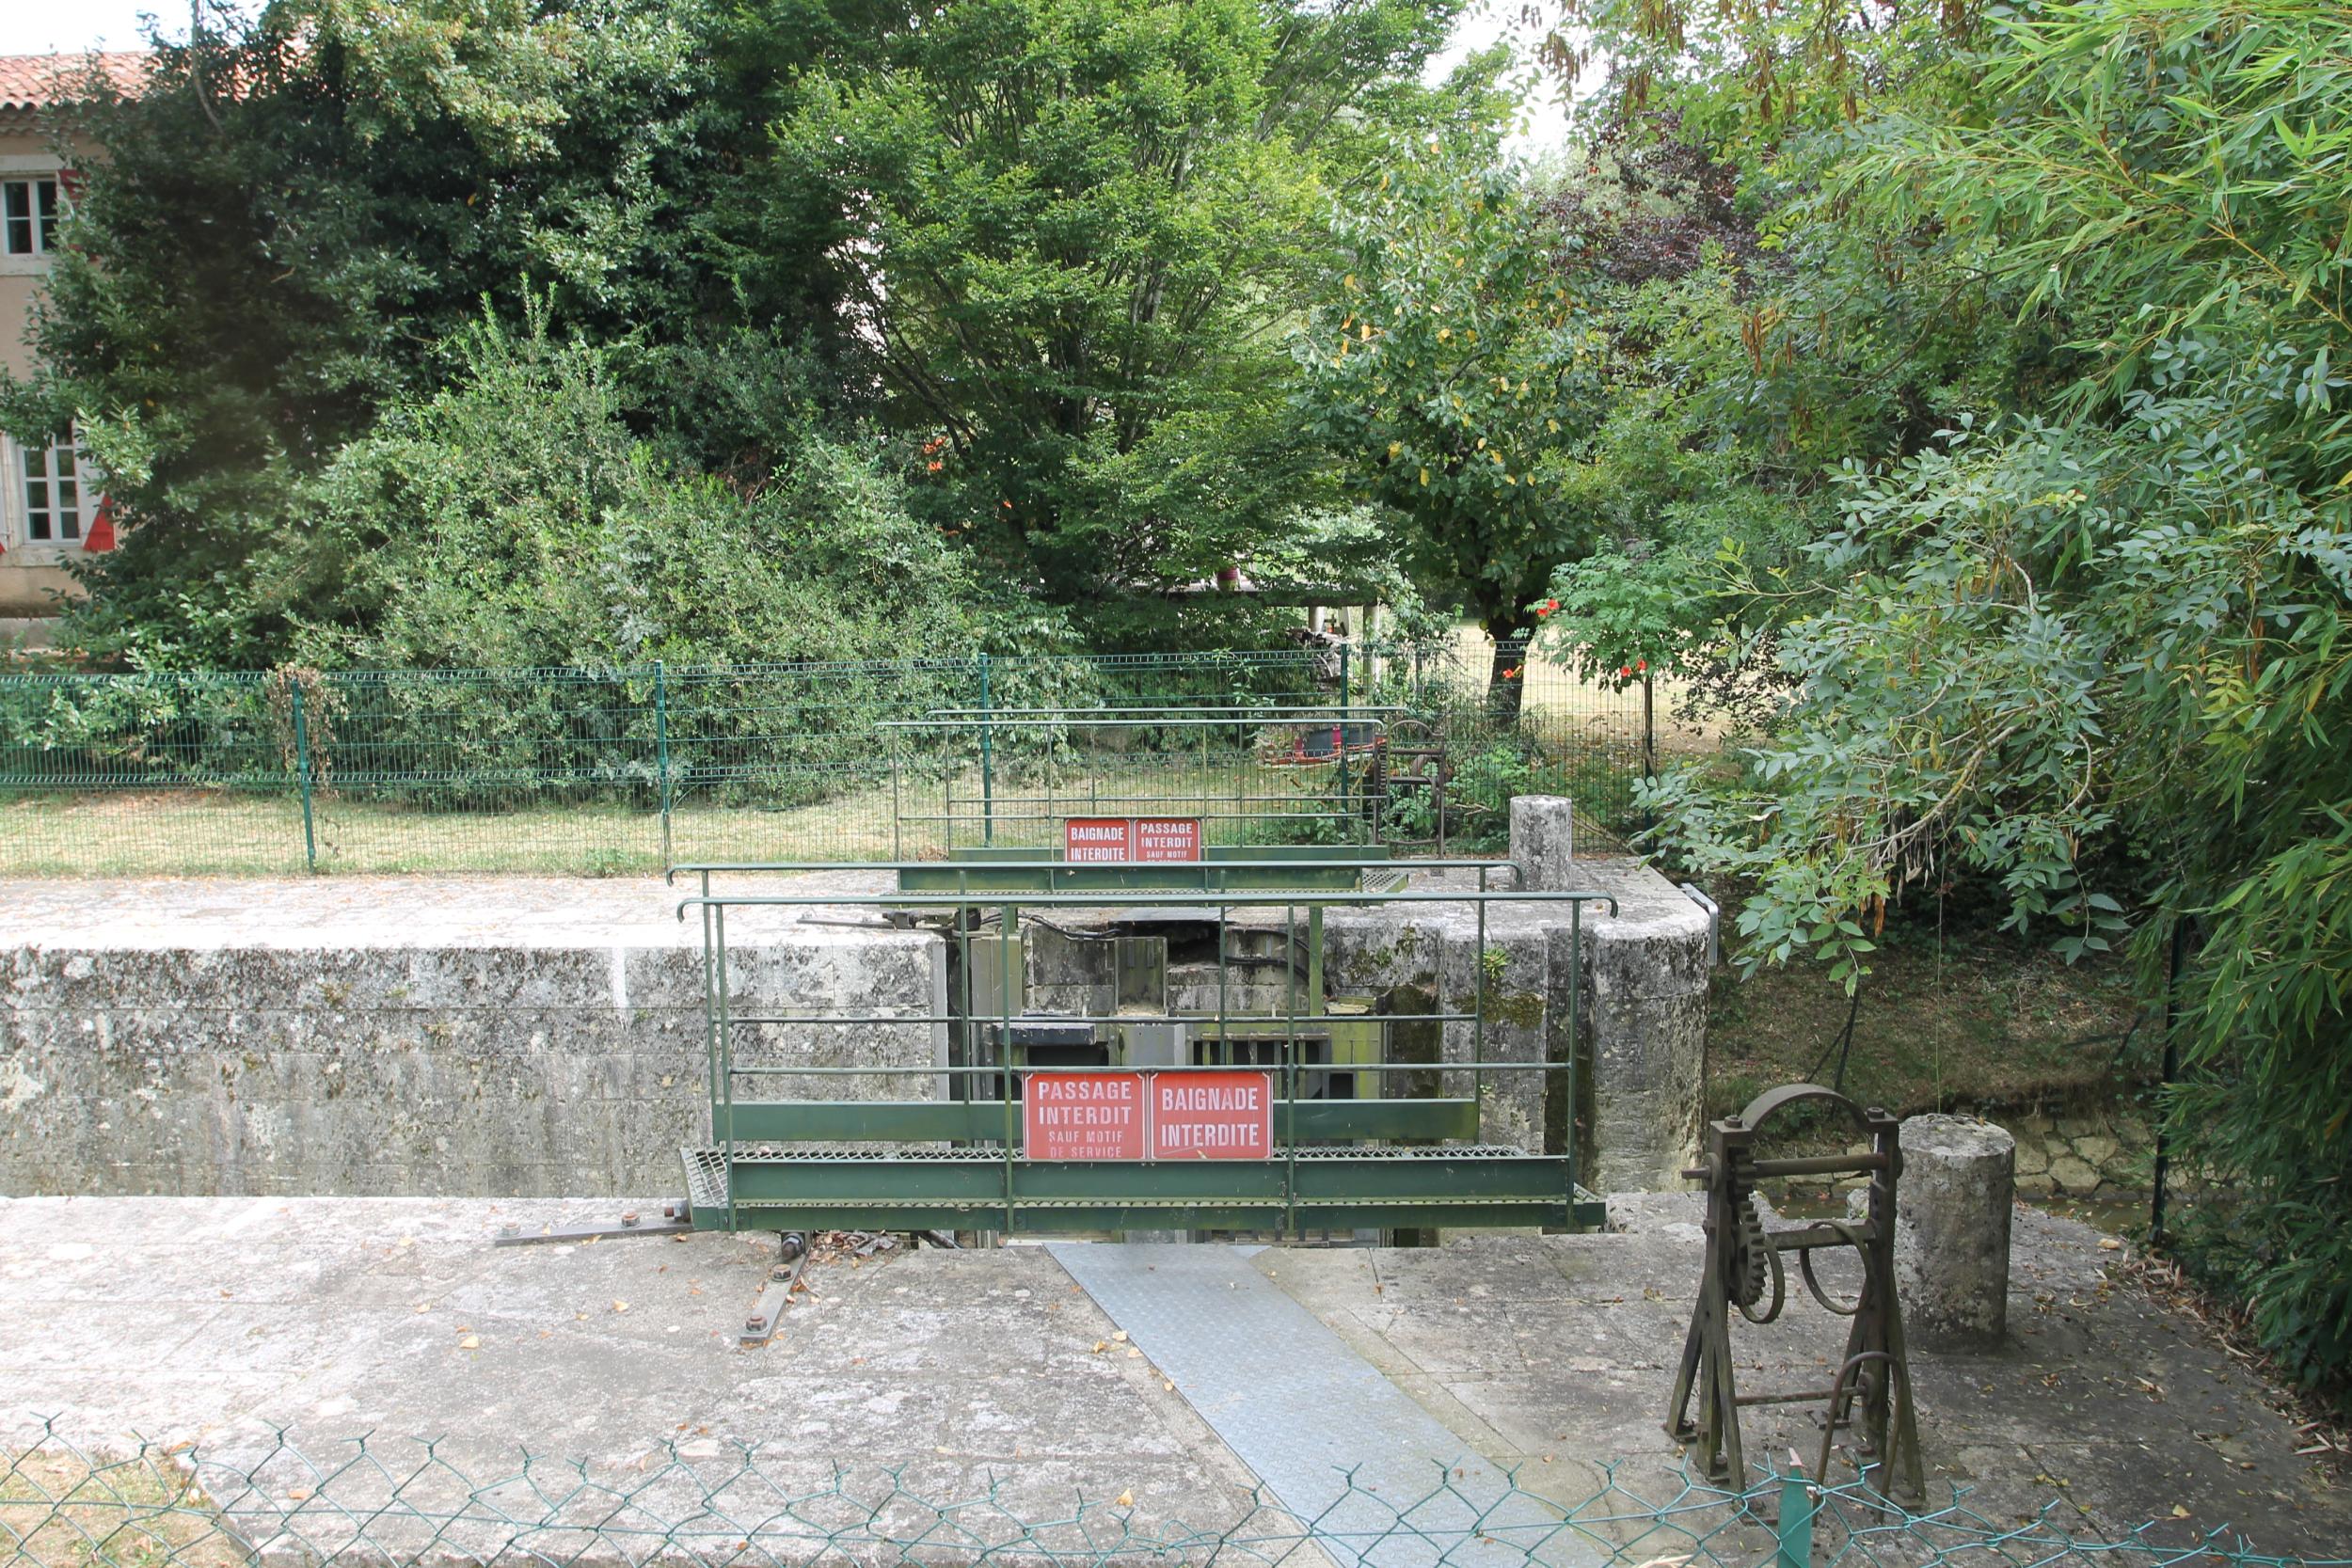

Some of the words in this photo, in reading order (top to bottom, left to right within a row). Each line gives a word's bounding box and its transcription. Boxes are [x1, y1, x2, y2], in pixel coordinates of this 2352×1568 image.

[1071, 827, 1124, 841] BAIGNADE
[1140, 823, 1193, 834] PASSAGE
[1140, 837, 1193, 848] INTERDIT
[1071, 847, 1125, 861] INTERDITE
[1146, 850, 1164, 859] SAUF
[1167, 850, 1188, 859] MOTIF
[1038, 1081, 1132, 1101] PASSAGE
[1161, 1087, 1259, 1111] BAIGNADE
[1039, 1106, 1132, 1125] INTERDIT
[1048, 1131, 1080, 1143] SAUF
[1086, 1131, 1123, 1143] MOTIF
[1161, 1124, 1260, 1147] INTERDITE
[1050, 1147, 1065, 1159] DE
[1071, 1146, 1122, 1159] SERVICE
